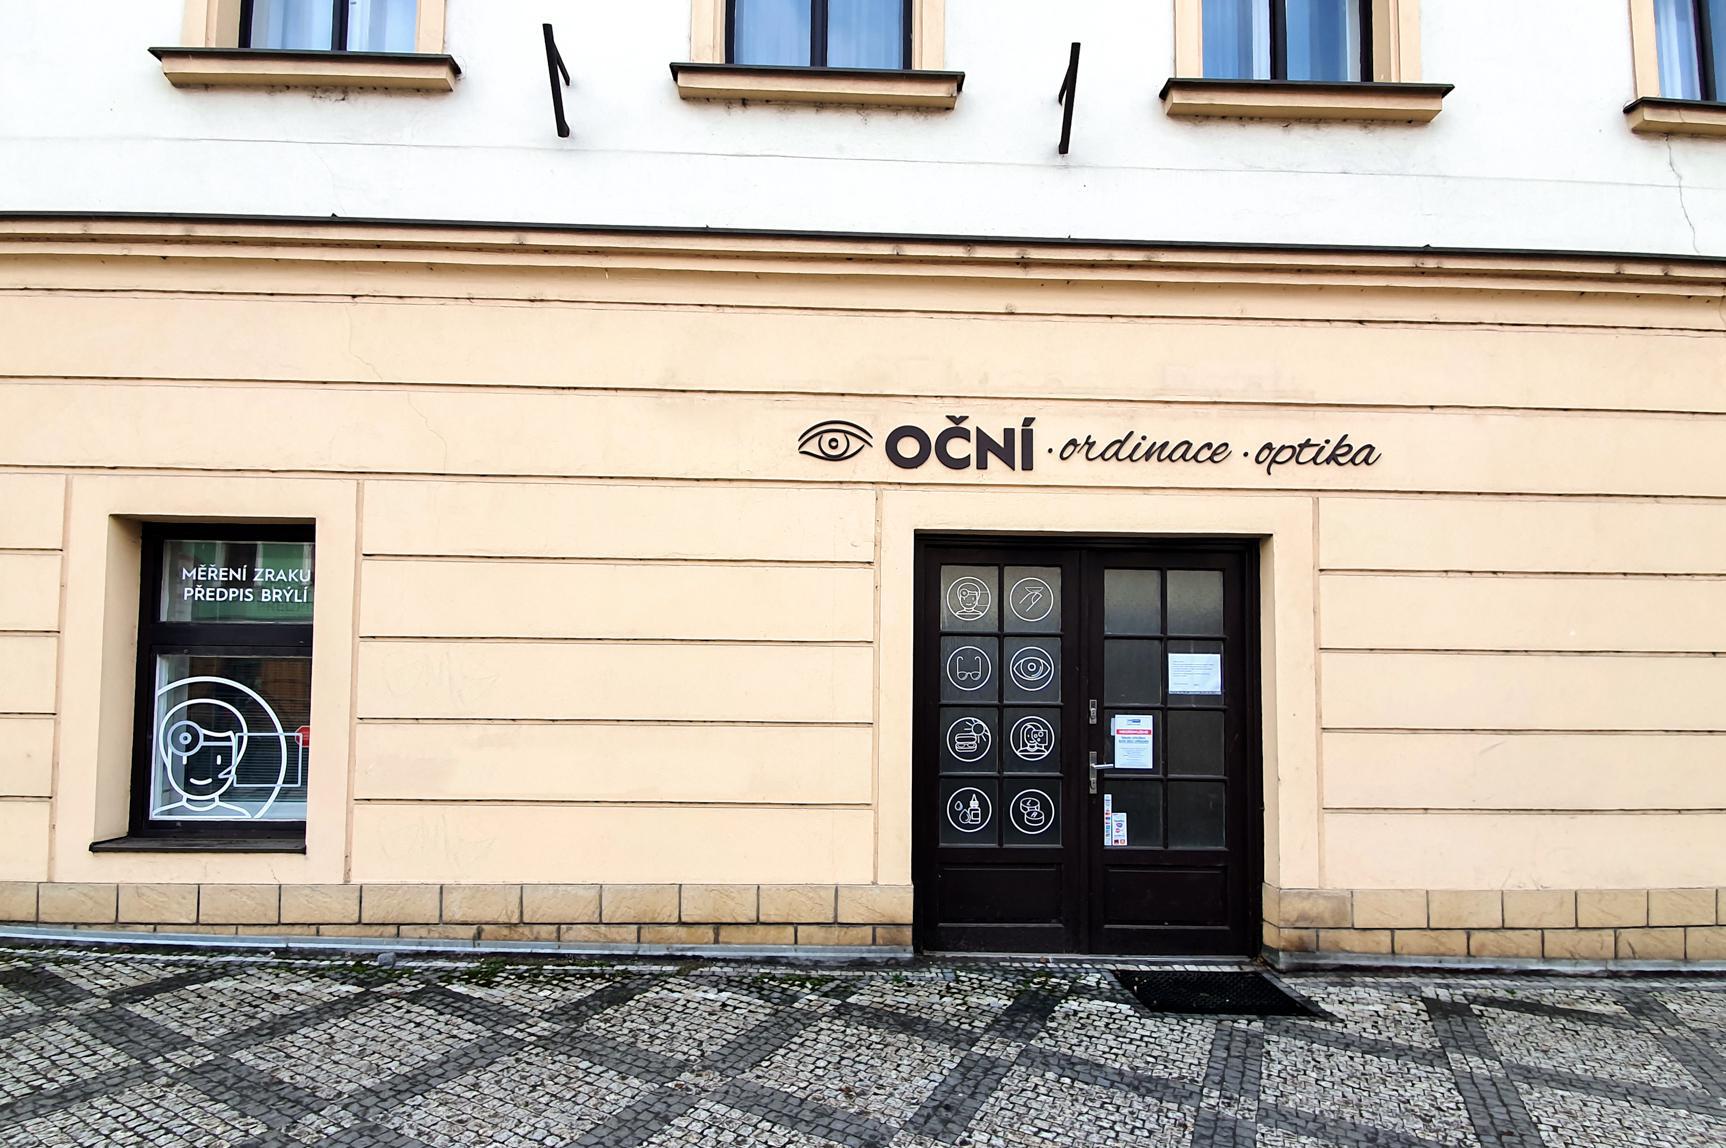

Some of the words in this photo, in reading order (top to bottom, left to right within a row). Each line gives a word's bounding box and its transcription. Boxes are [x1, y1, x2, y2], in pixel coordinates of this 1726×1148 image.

[885, 415, 1035, 471] OČNÍ
[1059, 430, 1232, 464] ordinace
[1254, 433, 1382, 476] optika
[182, 564, 248, 581] MĚŘENÍ
[253, 568, 311, 582] ZRAKU
[183, 584, 254, 602] PŘEDPIS
[261, 586, 308, 603] BRÝLÍ
